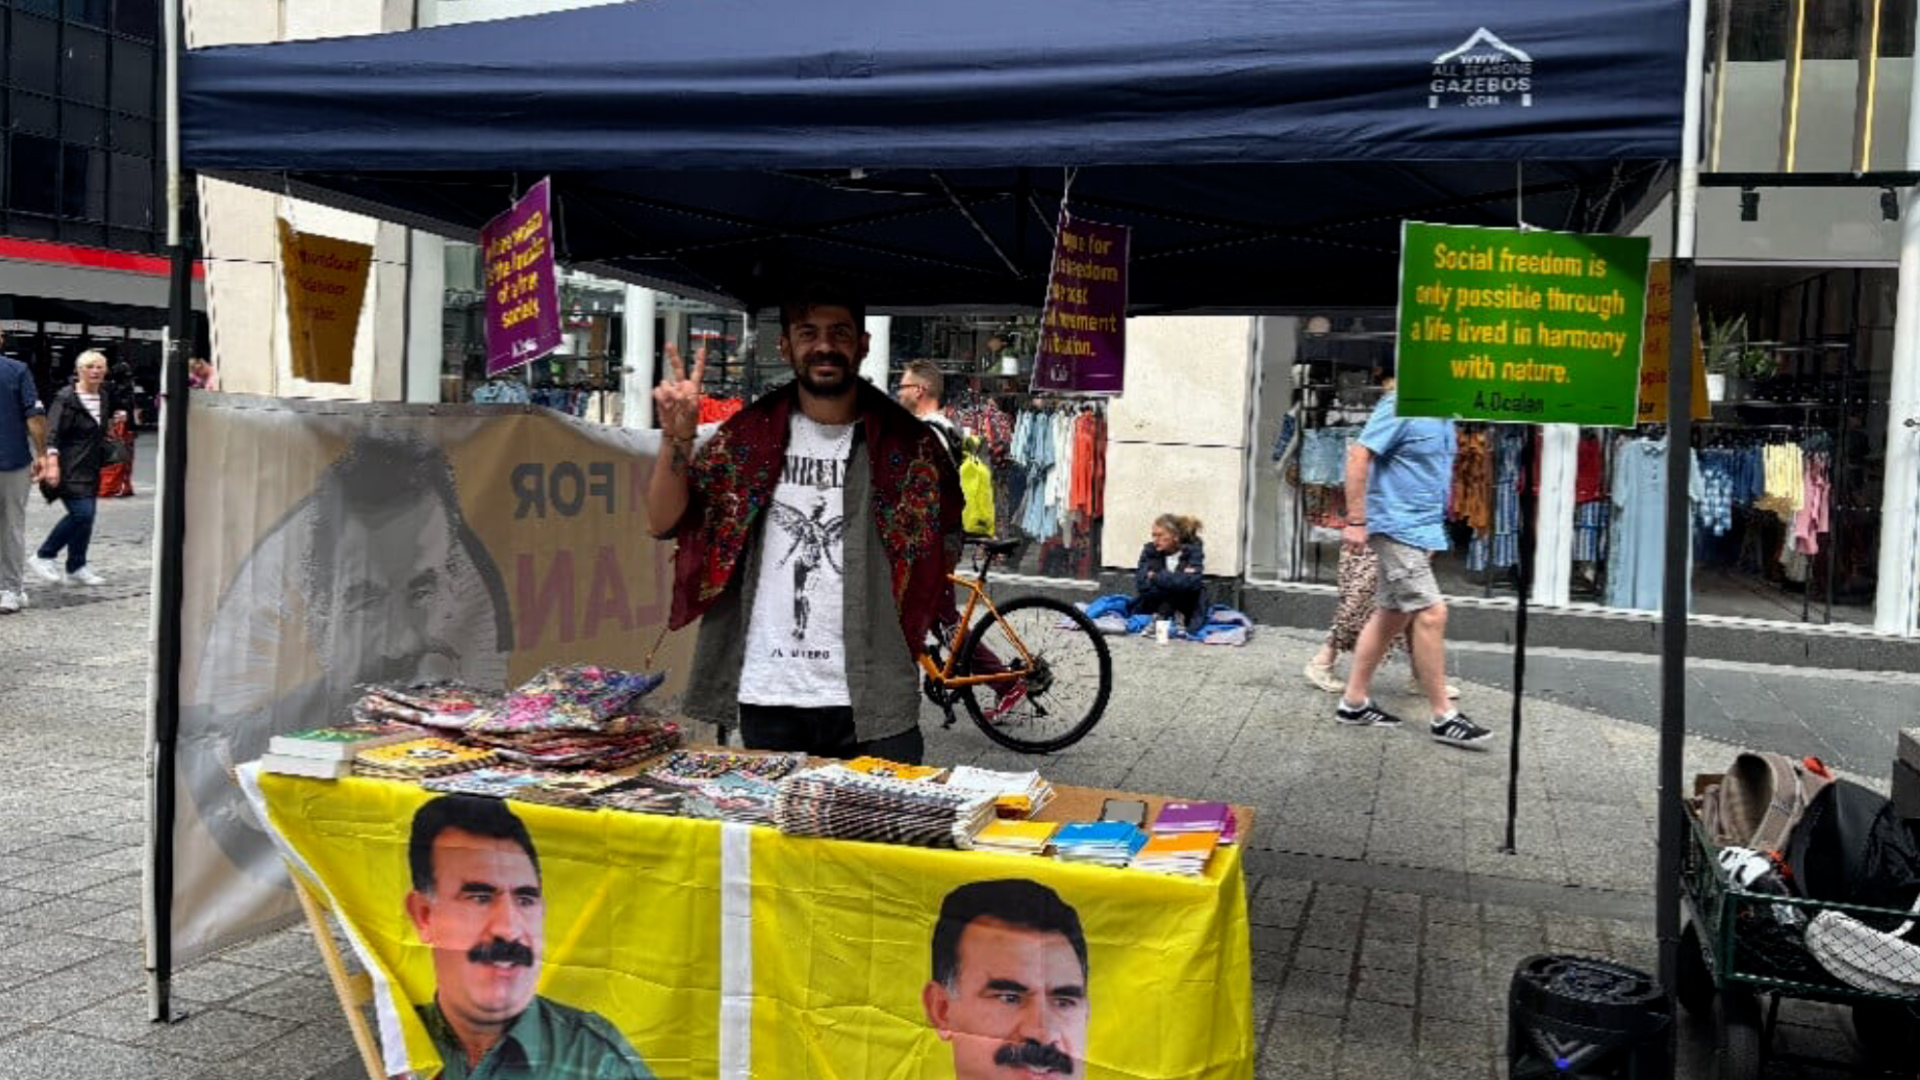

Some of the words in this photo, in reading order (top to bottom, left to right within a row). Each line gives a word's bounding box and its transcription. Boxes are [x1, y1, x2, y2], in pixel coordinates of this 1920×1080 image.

[1430, 77, 1531, 93] GAZEBOS
[1432, 64, 1459, 77] ALL
[1464, 62, 1532, 76] SEASONS
[1434, 242, 1493, 271] Social
[1499, 247, 1582, 277] freedom
[1588, 253, 1607, 278] is
[1415, 280, 1452, 312] only
[1456, 283, 1542, 313] possible
[1547, 286, 1626, 320] through
[1410, 321, 1420, 341] a
[1424, 316, 1452, 342] life
[1457, 318, 1507, 344] lived
[1513, 320, 1532, 345] in
[1538, 322, 1626, 357] harmony
[1451, 354, 1495, 380] with
[1502, 358, 1571, 384] nature.
